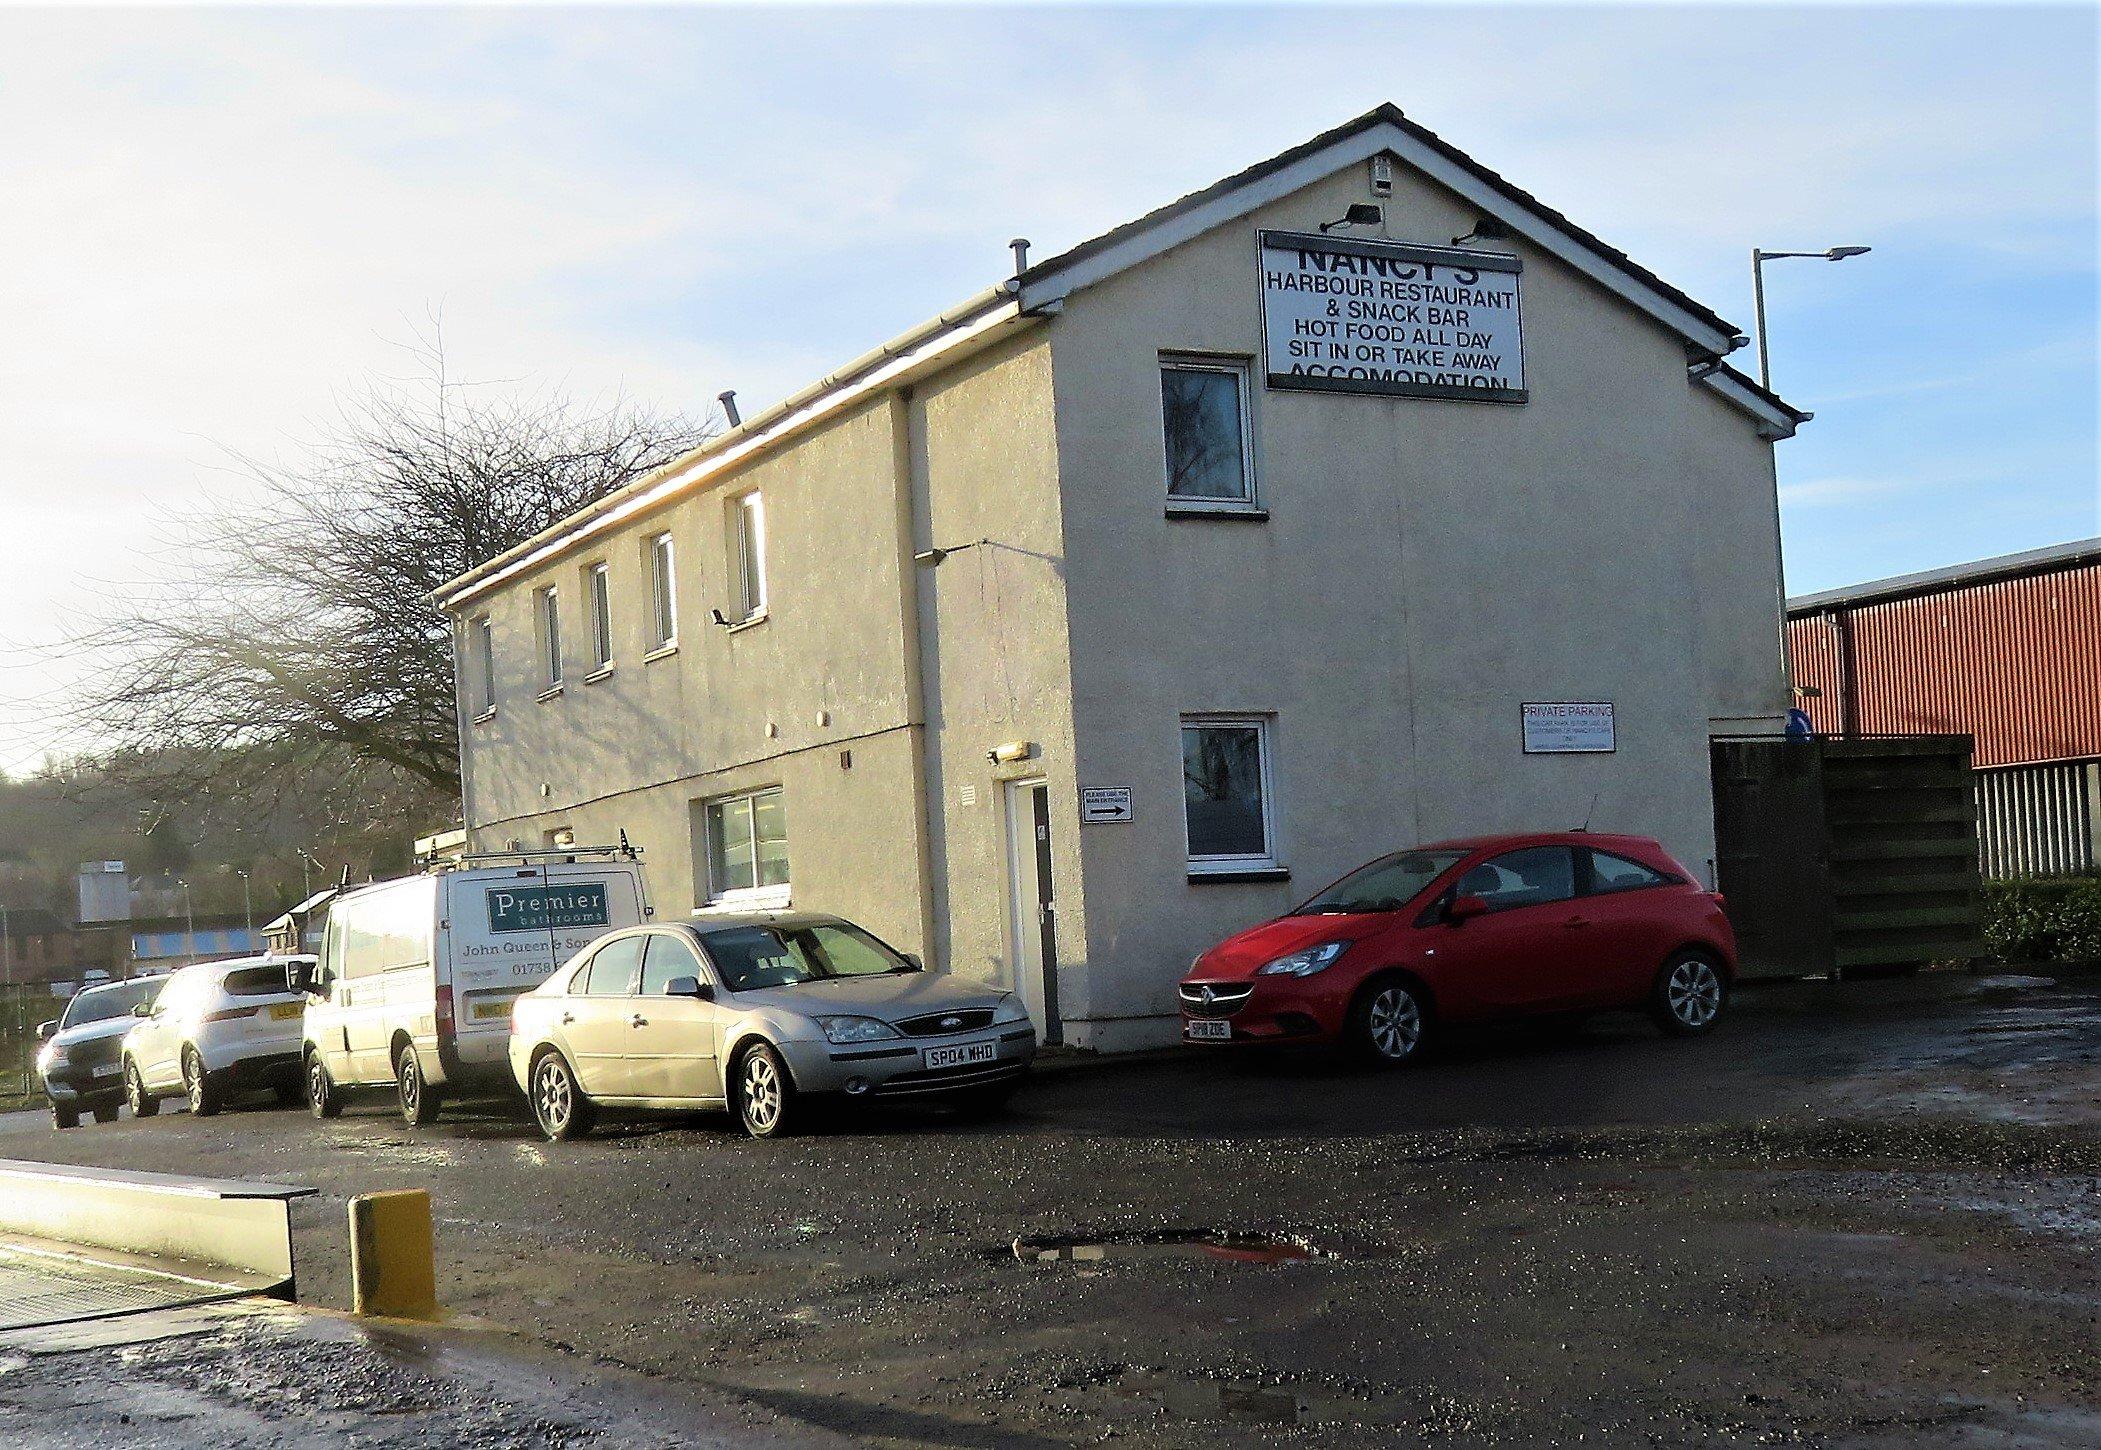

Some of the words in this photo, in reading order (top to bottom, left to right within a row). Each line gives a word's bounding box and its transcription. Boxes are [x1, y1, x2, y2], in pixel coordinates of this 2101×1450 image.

[1298, 250, 1480, 286] NANCYS
[1267, 271, 1374, 298] HARBOUR
[1380, 281, 1514, 310] RESTAURANT
[1326, 298, 1340, 317] &
[1348, 300, 1422, 324] SNACK
[1428, 307, 1470, 328] BAR
[1294, 318, 1339, 338] HOT
[1345, 322, 1406, 343] FOOD
[1412, 328, 1451, 346] ALL
[1456, 331, 1493, 350] DAY
[1288, 339, 1323, 358] SIT
[1329, 342, 1349, 360] IN
[1355, 344, 1386, 363] OR
[1392, 347, 1445, 367] TAKE
[1451, 352, 1501, 371] AWAY
[1523, 706, 1565, 717] PRIVATE
[1568, 705, 1614, 717] PARKING
[495, 893, 600, 917] Premier
[519, 912, 603, 926] bathrooms
[462, 943, 500, 957] John
[503, 941, 550, 955] Queen
[512, 962, 551, 976] 01738
[930, 1047, 965, 1066] SP04
[968, 1044, 993, 1061] WHD
